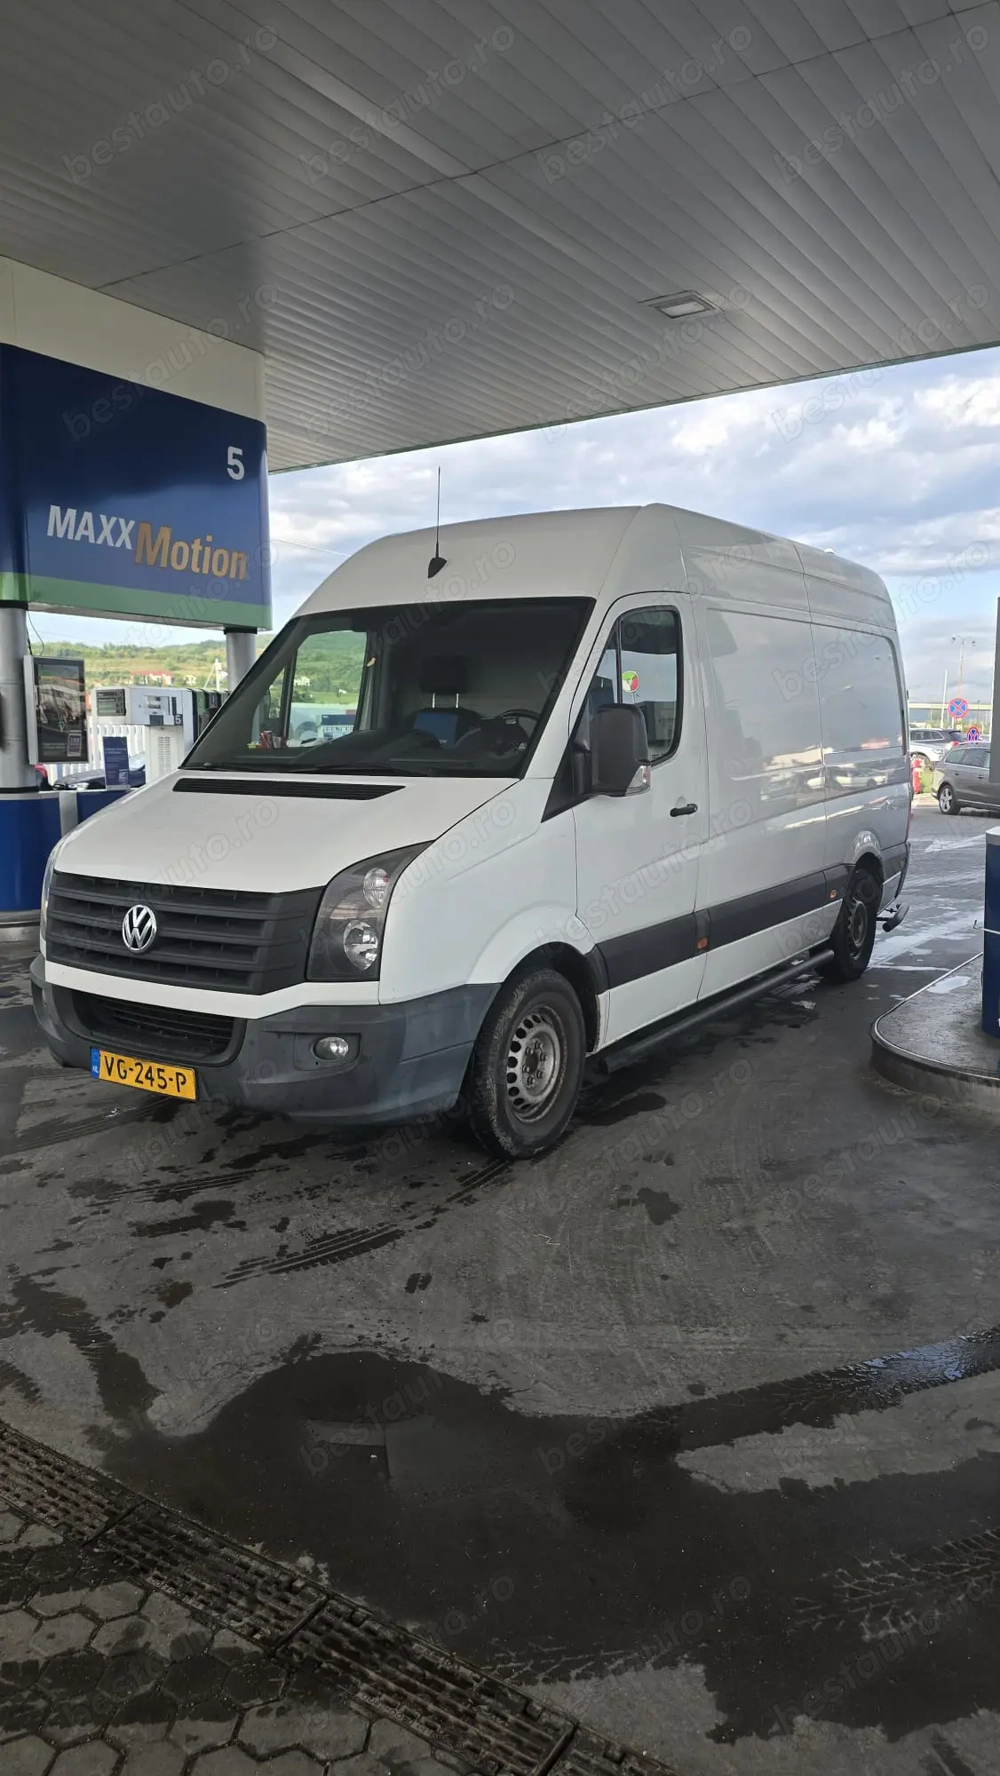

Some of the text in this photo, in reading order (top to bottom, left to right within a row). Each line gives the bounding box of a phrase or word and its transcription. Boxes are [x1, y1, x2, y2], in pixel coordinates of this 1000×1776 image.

[227, 446, 245, 481] 5
[122, 904, 157, 951] VW
[104, 1055, 187, 1092] VG-245-P
